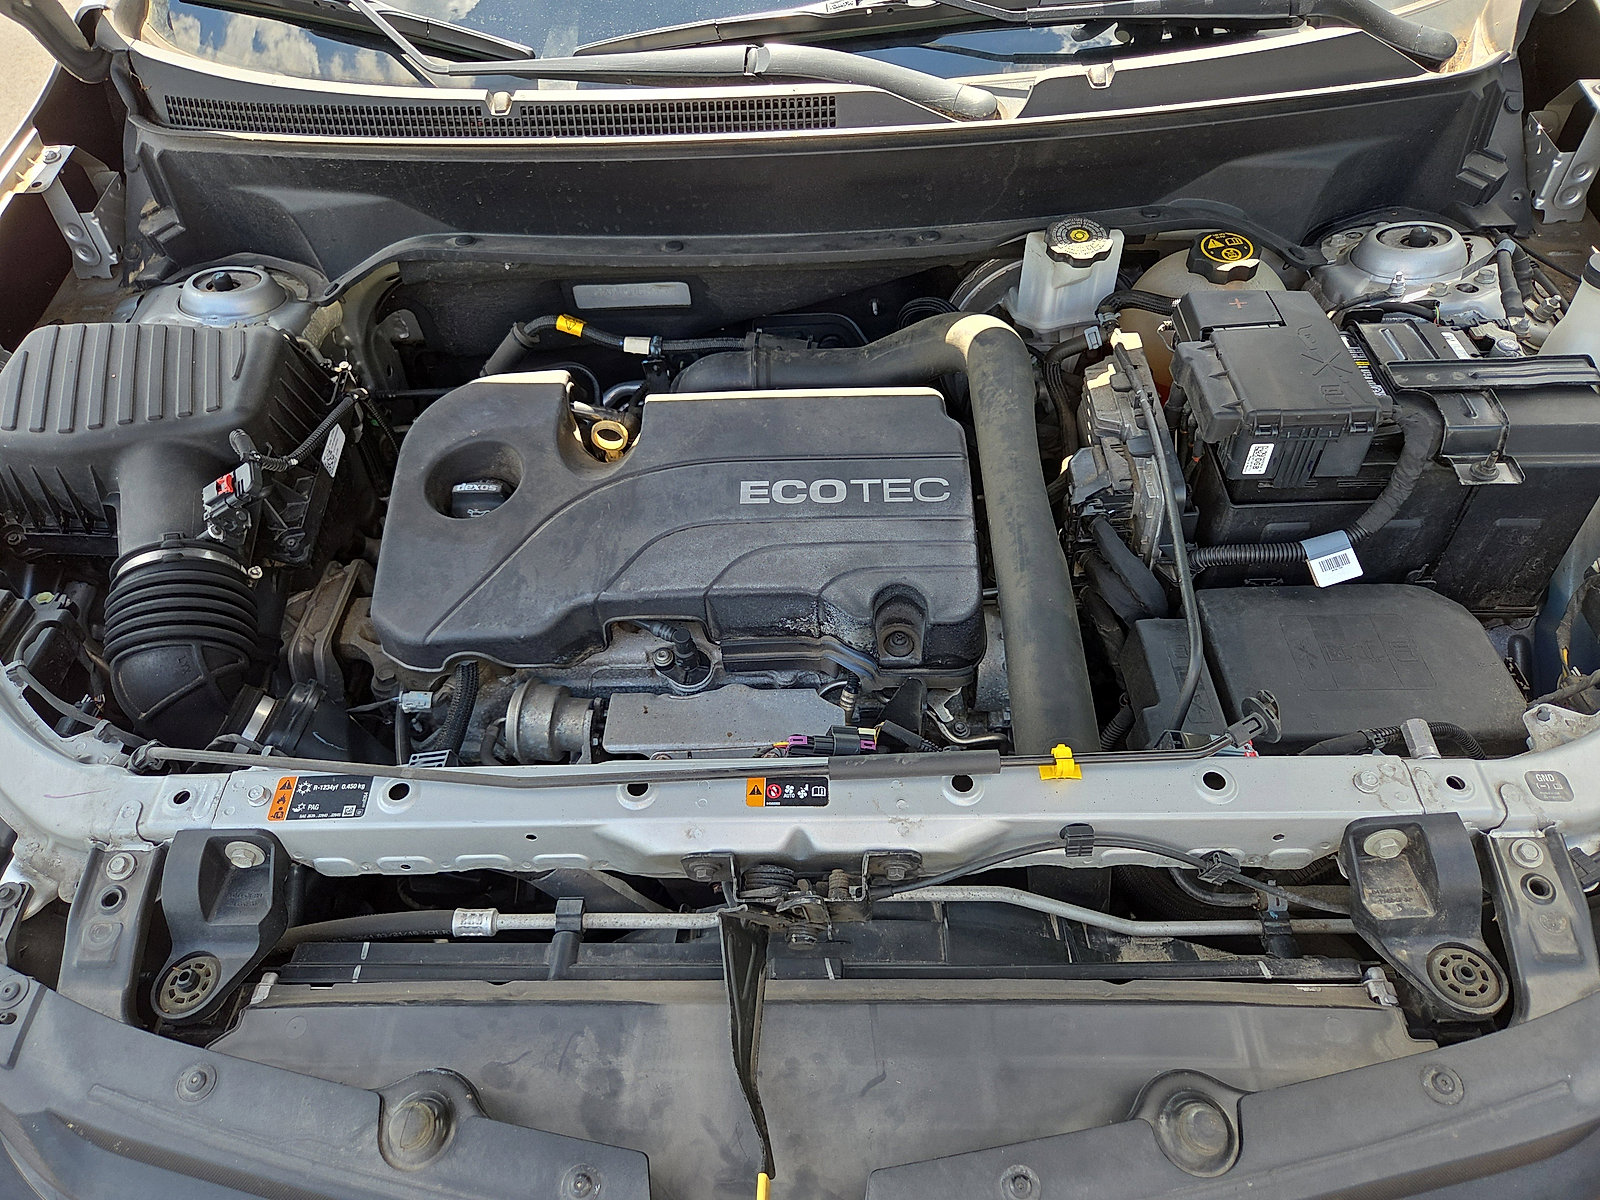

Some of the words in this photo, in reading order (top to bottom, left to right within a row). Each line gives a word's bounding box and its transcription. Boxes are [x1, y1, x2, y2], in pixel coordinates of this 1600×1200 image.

[456, 483, 499, 491] dexos
[739, 477, 951, 505] ECOTEC
[1535, 773, 1555, 782] GND
[312, 783, 339, 792] R-1234yf
[358, 782, 366, 791] kg
[307, 803, 320, 811] PAG
